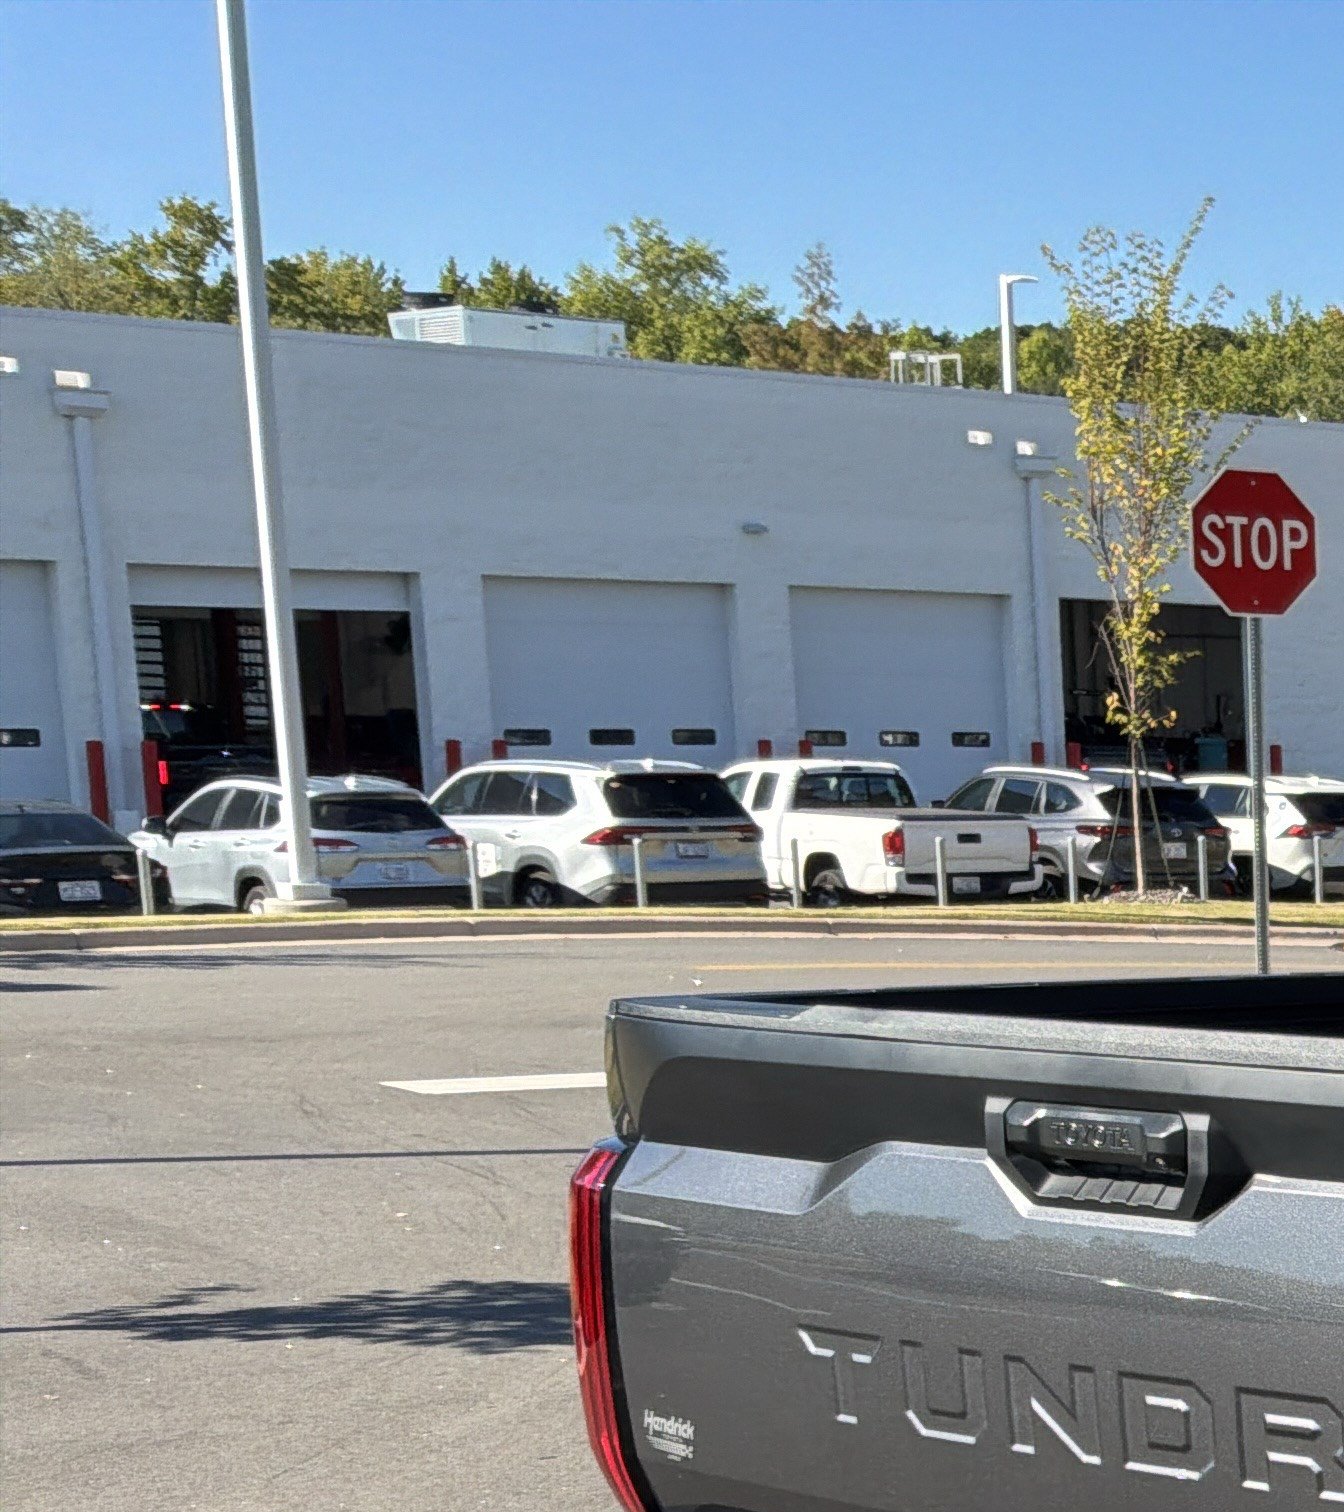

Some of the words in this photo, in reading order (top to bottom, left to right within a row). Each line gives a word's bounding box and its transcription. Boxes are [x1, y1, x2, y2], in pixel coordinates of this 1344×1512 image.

[1200, 513, 1309, 571] STOP
[1050, 1121, 1136, 1152] TOYOTA
[643, 1408, 695, 1440] Hendrick
